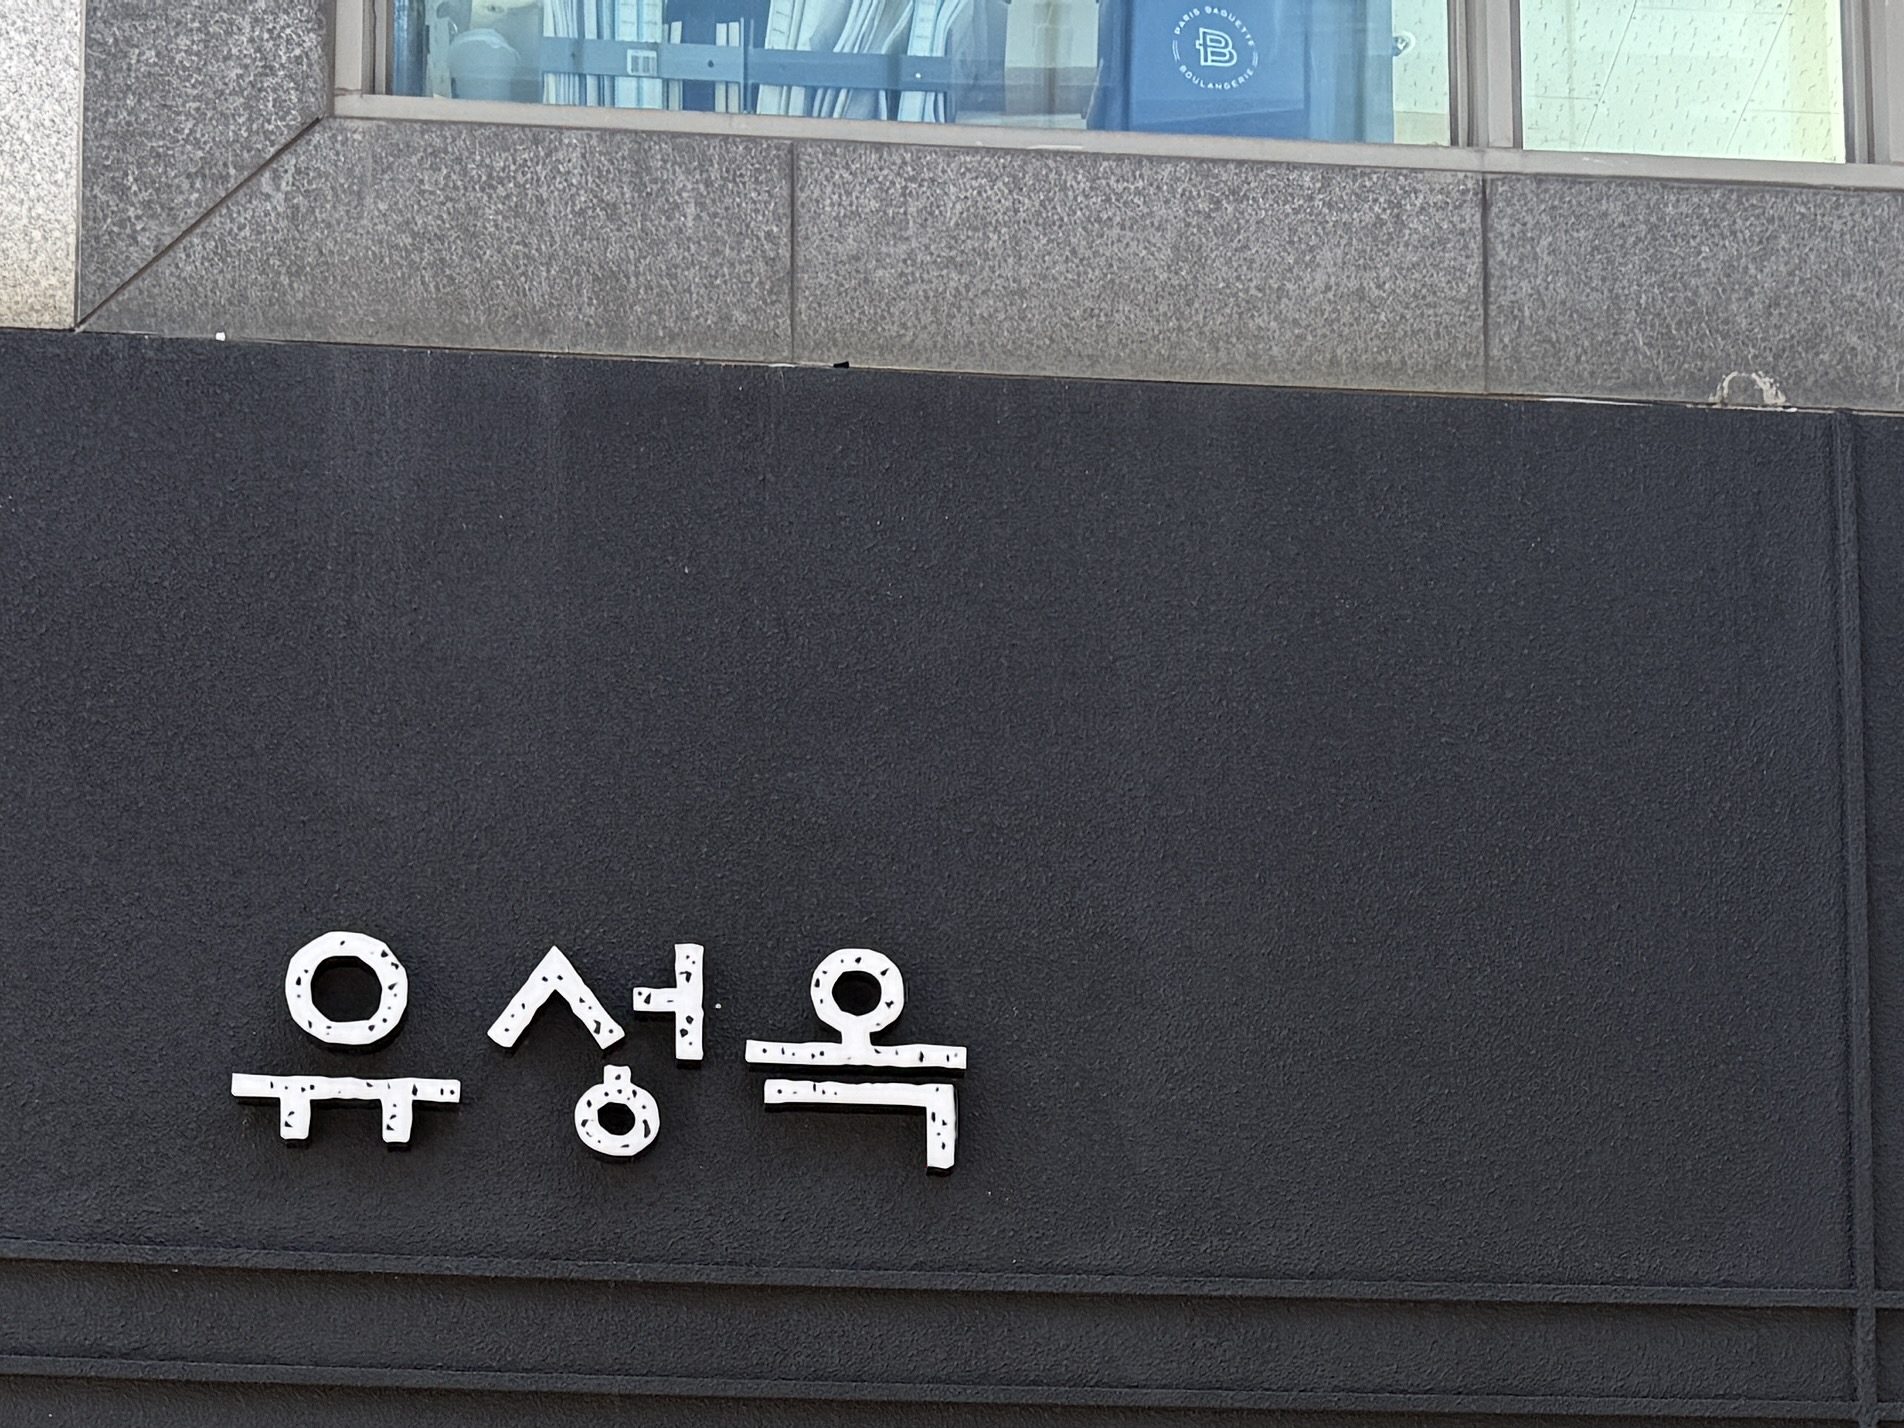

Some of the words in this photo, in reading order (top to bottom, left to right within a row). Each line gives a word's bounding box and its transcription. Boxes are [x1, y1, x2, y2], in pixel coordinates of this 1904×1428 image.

[1174, 7, 1201, 35] PARIS
[1179, 64, 1254, 91] BOULANGERIE
[230, 930, 968, 1170] 유성옥
